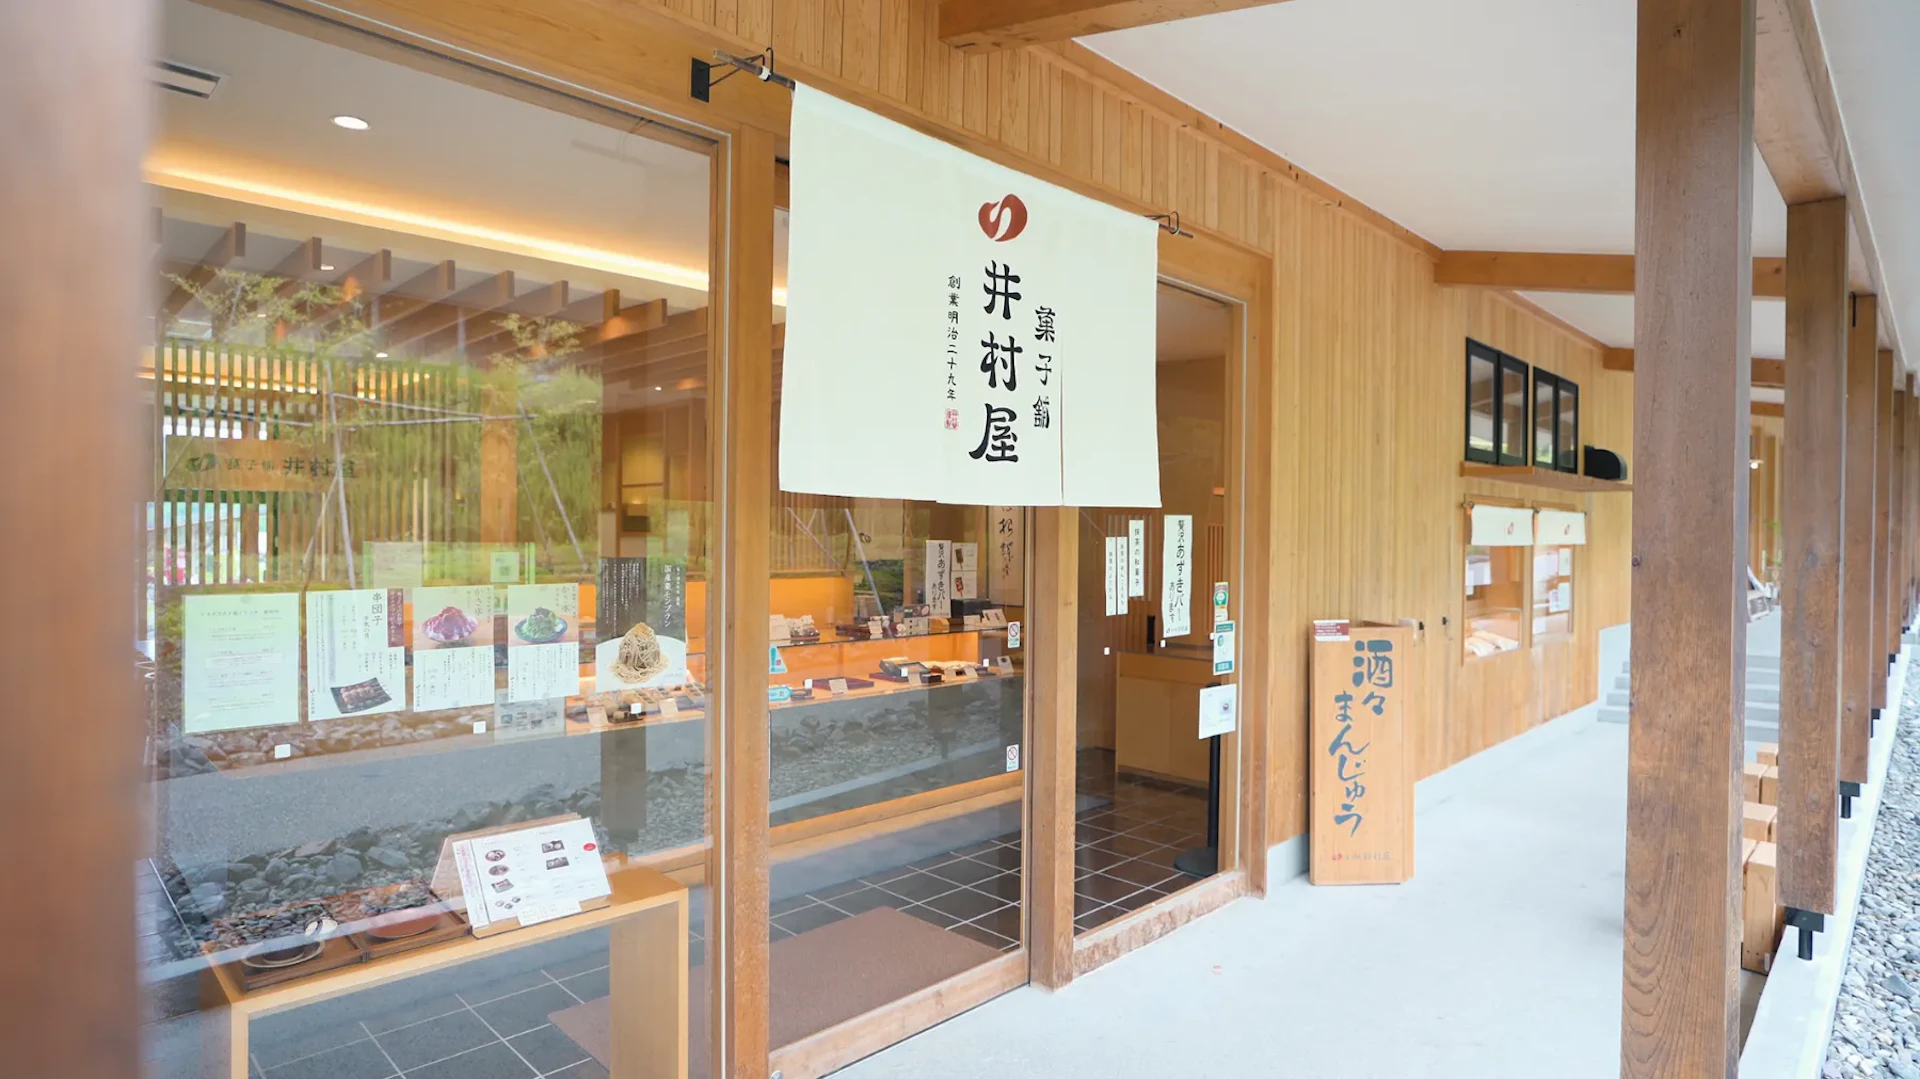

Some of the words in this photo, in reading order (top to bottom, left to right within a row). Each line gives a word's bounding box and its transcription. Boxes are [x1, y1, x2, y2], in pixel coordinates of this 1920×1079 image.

[947, 275, 960, 400] 創業明治二十九年
[967, 259, 1023, 463] 井村屋
[371, 592, 383, 626] 串団子
[1328, 690, 1371, 838] まんじゅう
